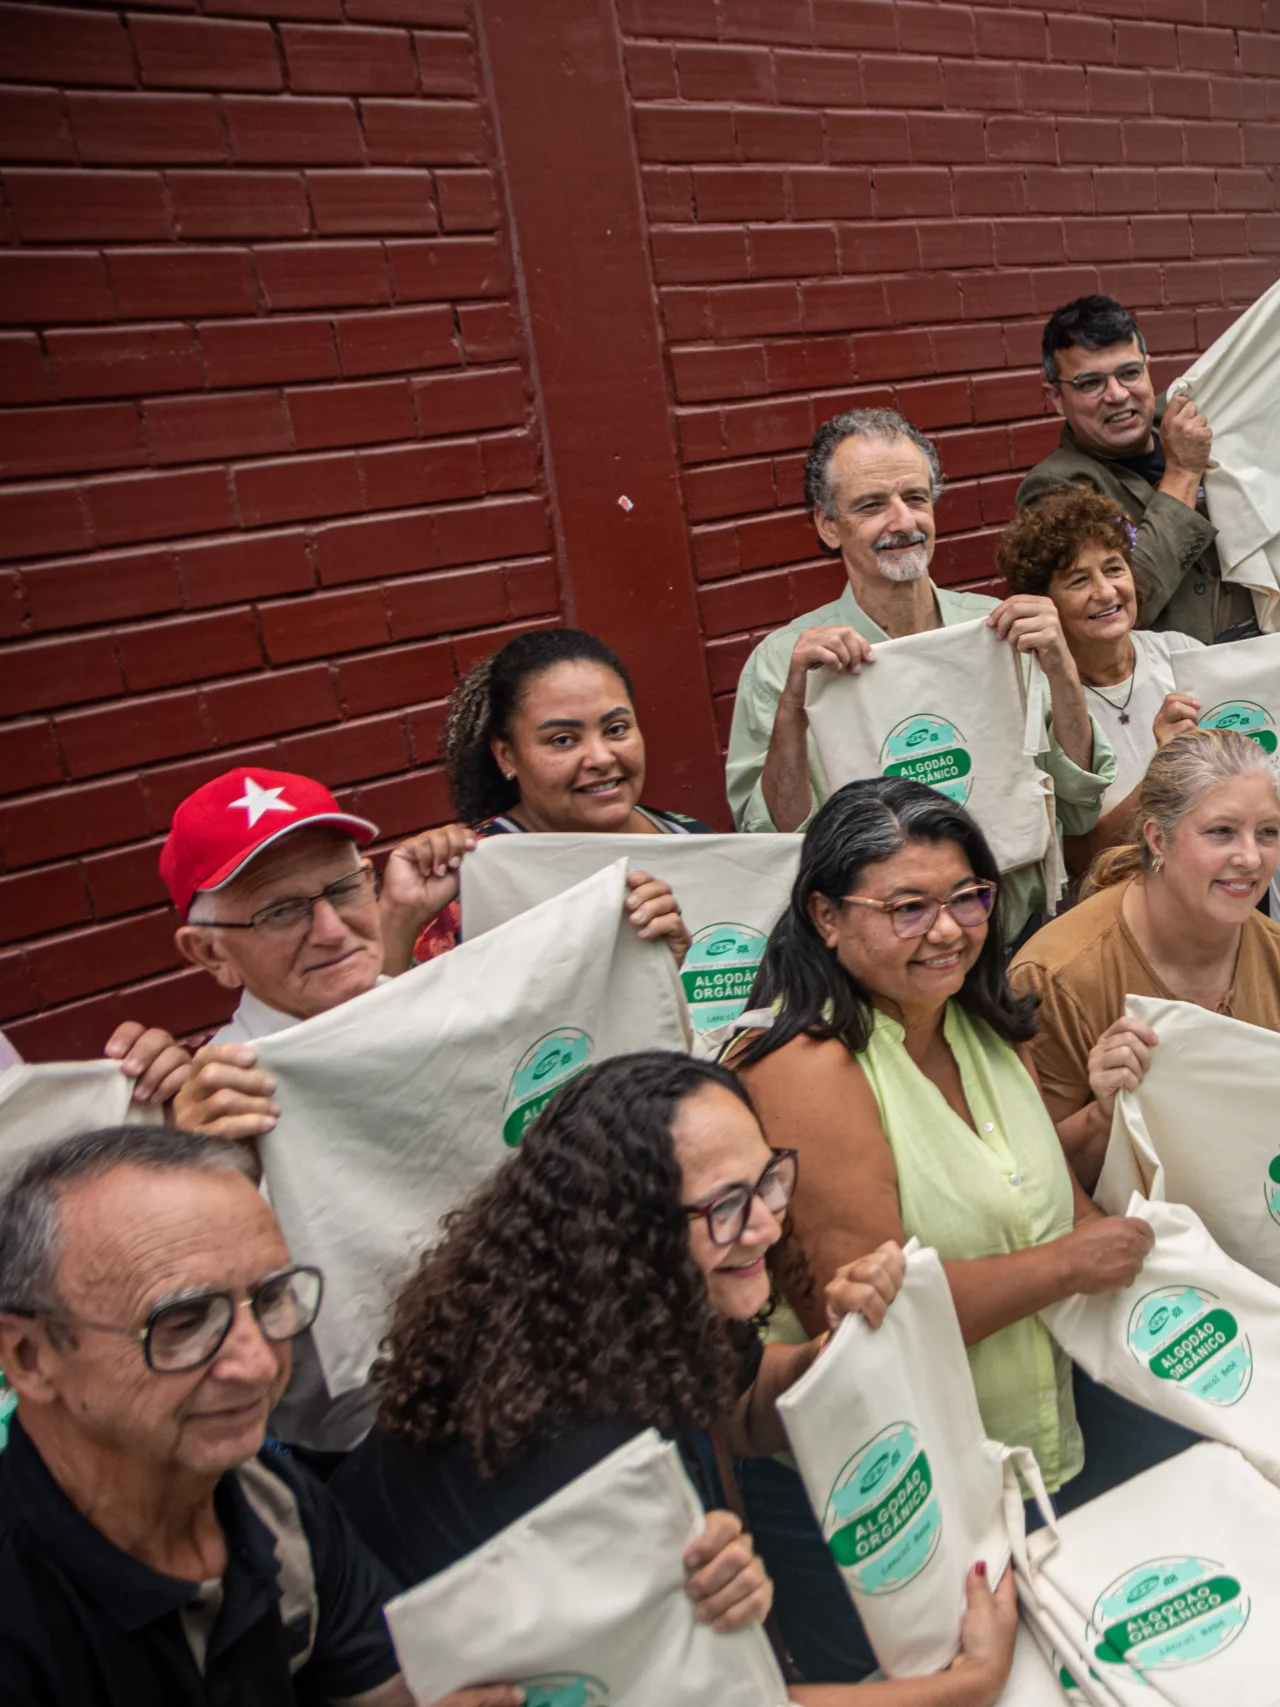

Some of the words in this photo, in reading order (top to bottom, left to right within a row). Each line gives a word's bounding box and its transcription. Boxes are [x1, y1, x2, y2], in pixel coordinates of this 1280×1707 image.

[900, 755, 954, 777] ALGODÃO
[1161, 1322, 1214, 1369] ALGODÃO
[1169, 1331, 1226, 1379] ORGÂNICO
[855, 1469, 921, 1541] ALGODÃO
[855, 1480, 928, 1557] ORGÂNICO
[1126, 1586, 1210, 1632] ALGODÃO
[1128, 1593, 1221, 1643] ORGÂNICO
